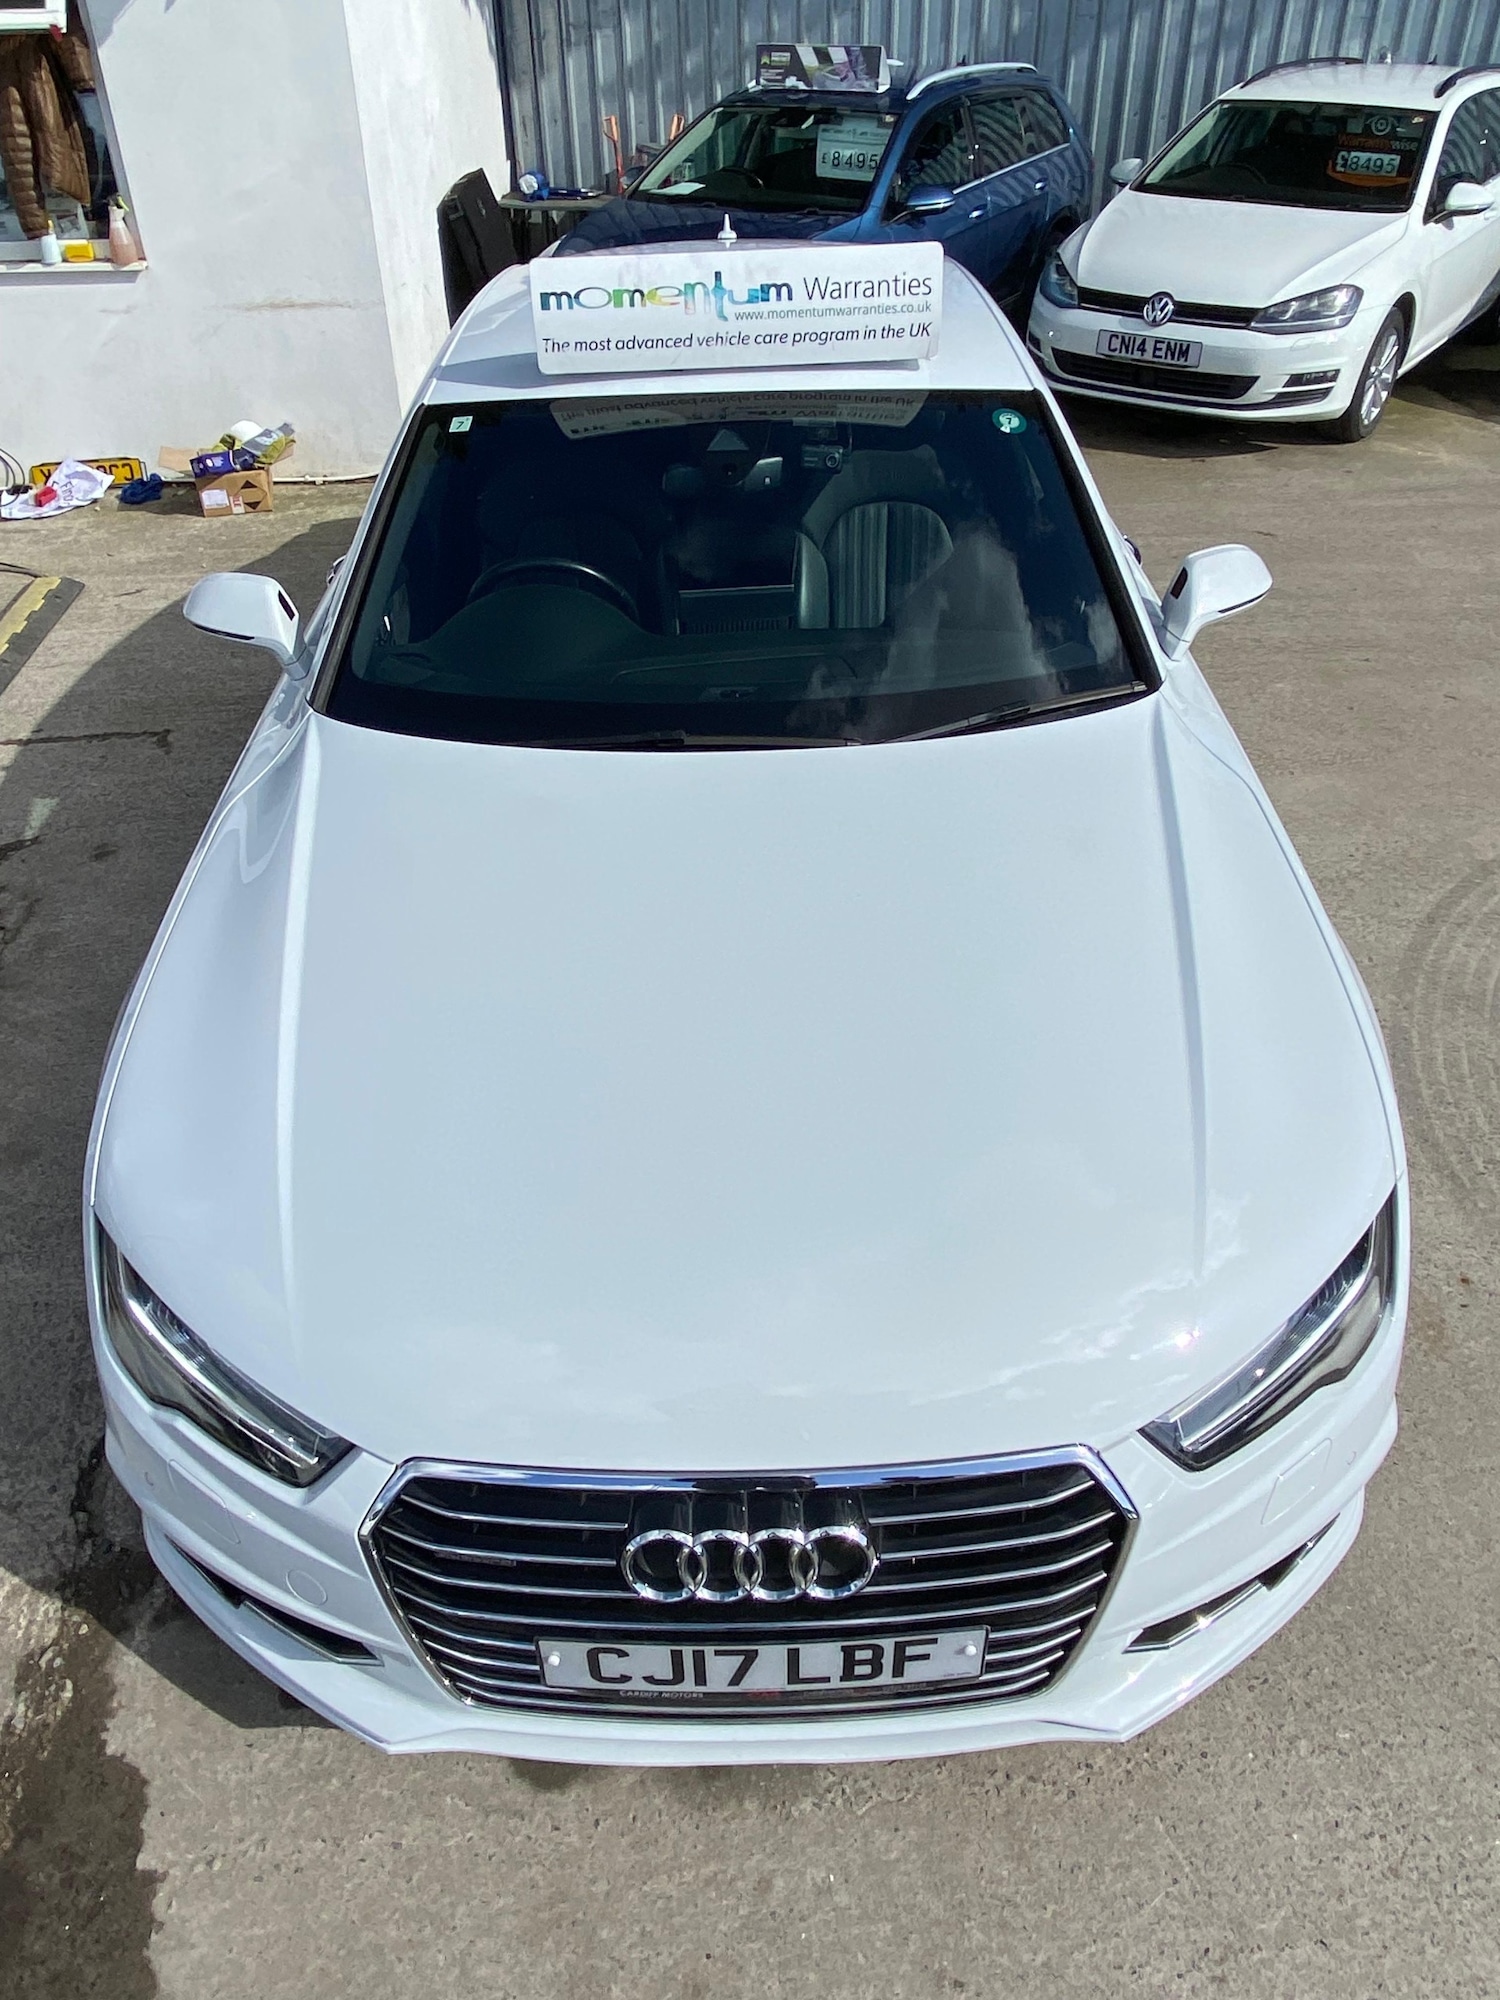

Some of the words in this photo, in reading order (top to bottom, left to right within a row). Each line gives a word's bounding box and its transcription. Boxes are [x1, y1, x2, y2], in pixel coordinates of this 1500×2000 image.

[1336, 150, 1397, 174] £8495
[540, 270, 793, 322] momentum
[803, 271, 932, 301] Warranties
[734, 301, 932, 321] www.momentumwarranties.co.uk
[542, 338, 570, 353] The
[574, 337, 611, 351] most
[615, 333, 693, 350] advanced
[697, 331, 750, 347] vehicle
[754, 333, 788, 345] care
[791, 328, 859, 346] program
[863, 325, 877, 340] in
[880, 324, 905, 339] the
[909, 322, 932, 338] UK
[1107, 334, 1147, 357] CN14
[1152, 340, 1190, 363] ENM
[586, 1646, 759, 1687] CJ17
[787, 1638, 939, 1686] LBF
[661, 1691, 704, 1699] MOTORS
